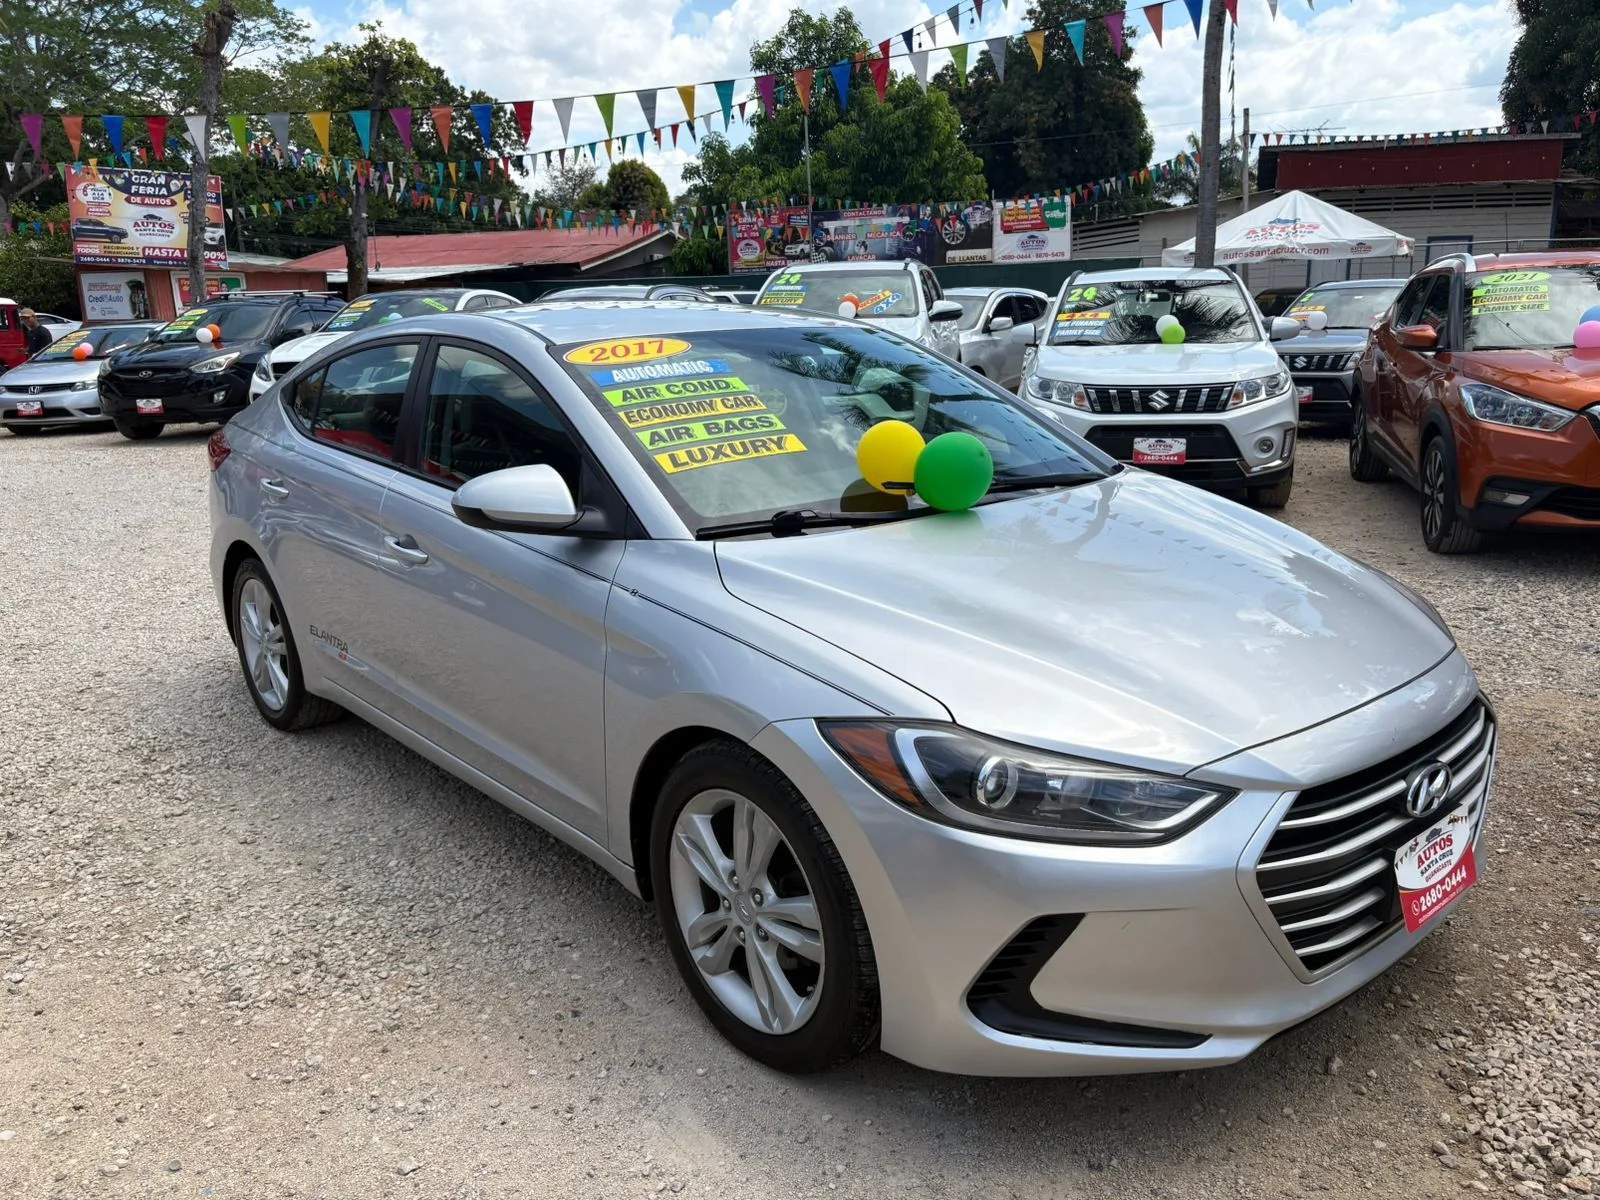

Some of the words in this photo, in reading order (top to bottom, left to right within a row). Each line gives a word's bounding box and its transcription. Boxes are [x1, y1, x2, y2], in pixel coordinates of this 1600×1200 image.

[131, 174, 166, 184] GRAN
[131, 186, 168, 196] FERIA
[144, 197, 172, 205] AUTOS
[133, 221, 175, 230] AUTOS
[1246, 224, 1321, 236] AUTOS
[144, 248, 181, 258] HASTA
[776, 274, 802, 285] 24
[1494, 273, 1538, 282] 2021
[1068, 287, 1098, 302] 24
[1484, 285, 1540, 294] AUTOMATIC
[1474, 295, 1523, 304] ECONOMY
[1478, 305, 1517, 313] FAMILY
[588, 339, 665, 362] 2017
[611, 360, 714, 384] AUTOMATIC
[622, 386, 662, 404] AIR
[663, 379, 736, 396] COND.
[626, 399, 717, 424] ECONOMY
[723, 395, 760, 410] CAR
[649, 426, 696, 447] AIR
[702, 415, 775, 436] BAGS
[668, 436, 788, 468] LUXURY
[310, 624, 349, 653] ELANTRA
[1417, 834, 1453, 869] AUTOS
[1420, 858, 1438, 877] SANTA
[1439, 849, 1453, 861] CRUZ
[1425, 859, 1452, 882] GUANACASTE
[1420, 865, 1466, 911] 2680-0444
